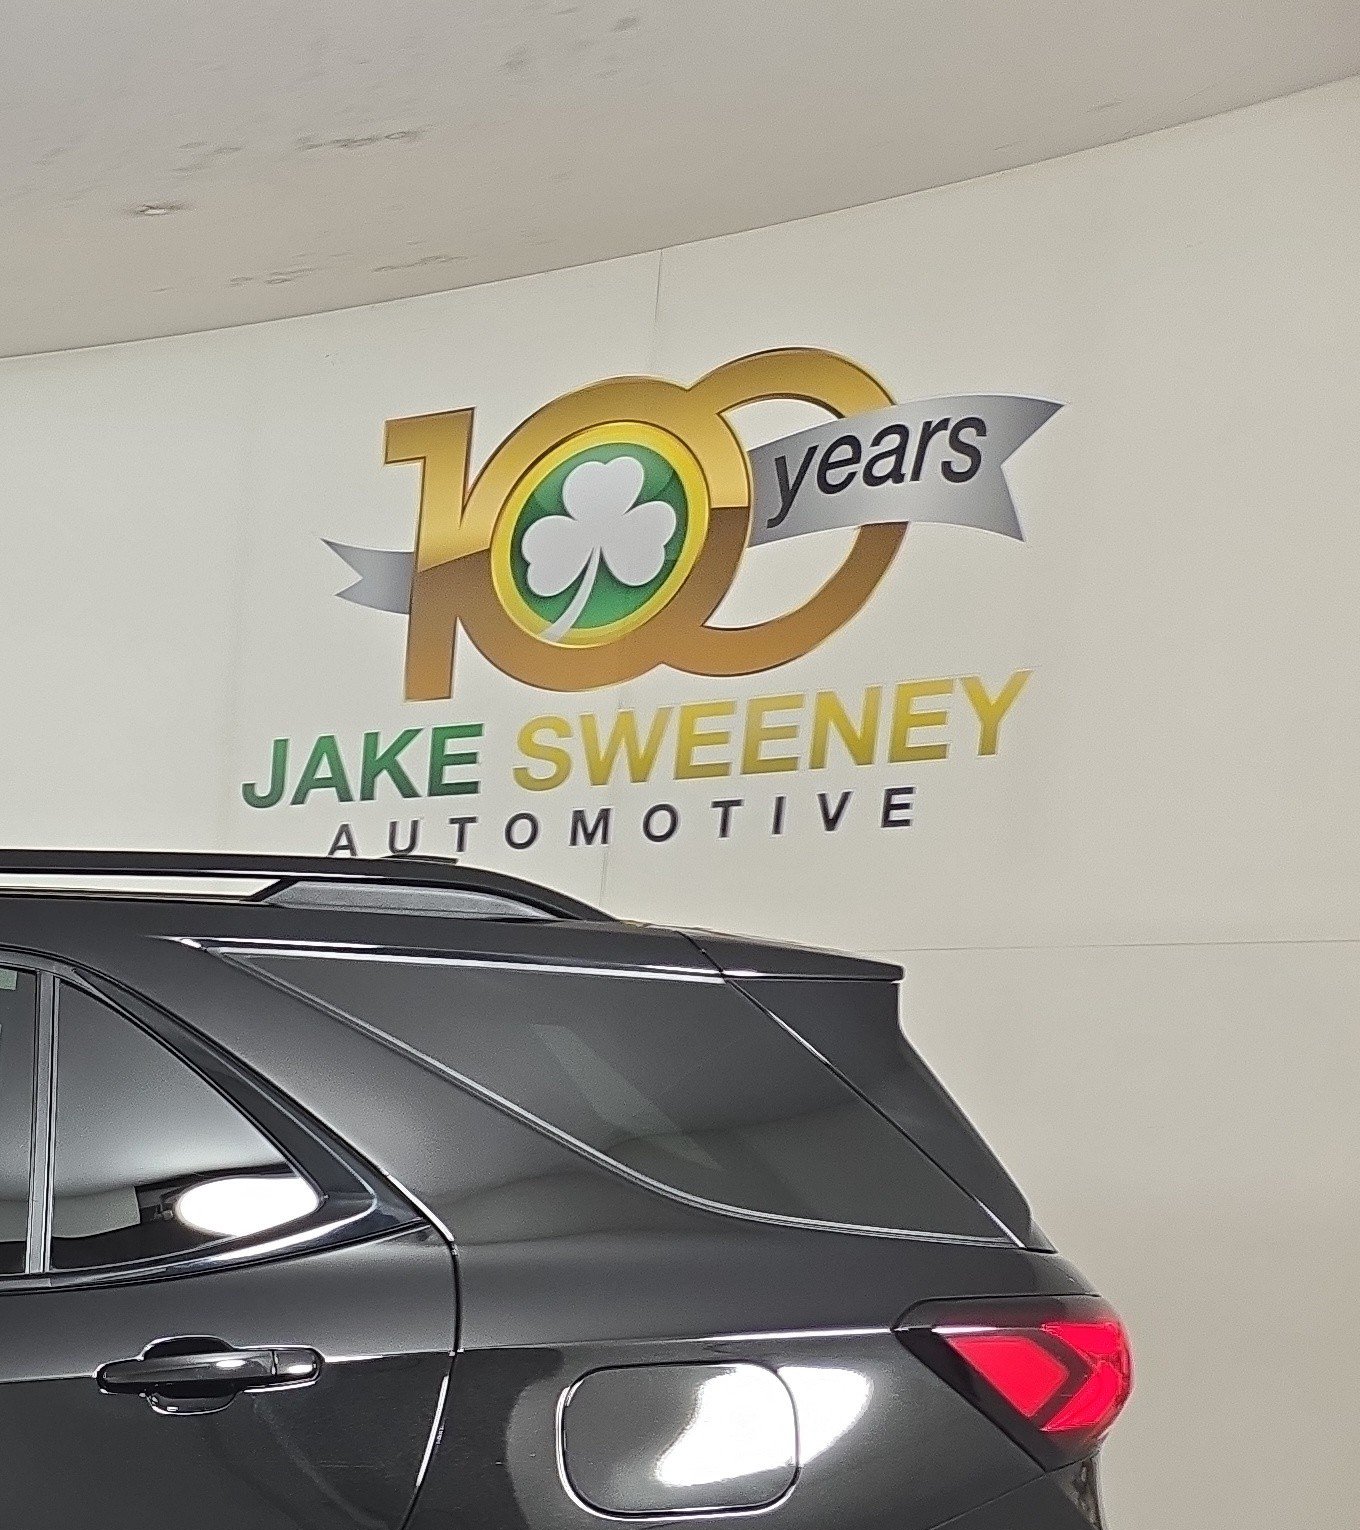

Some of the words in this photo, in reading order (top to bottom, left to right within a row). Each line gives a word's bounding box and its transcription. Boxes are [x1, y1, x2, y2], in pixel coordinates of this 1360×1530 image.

[382, 346, 909, 704] 100
[765, 415, 987, 530] years
[241, 722, 486, 810] JAKE
[510, 668, 1036, 793] SWEENEY
[328, 785, 917, 858] AUTOMOTIVE
